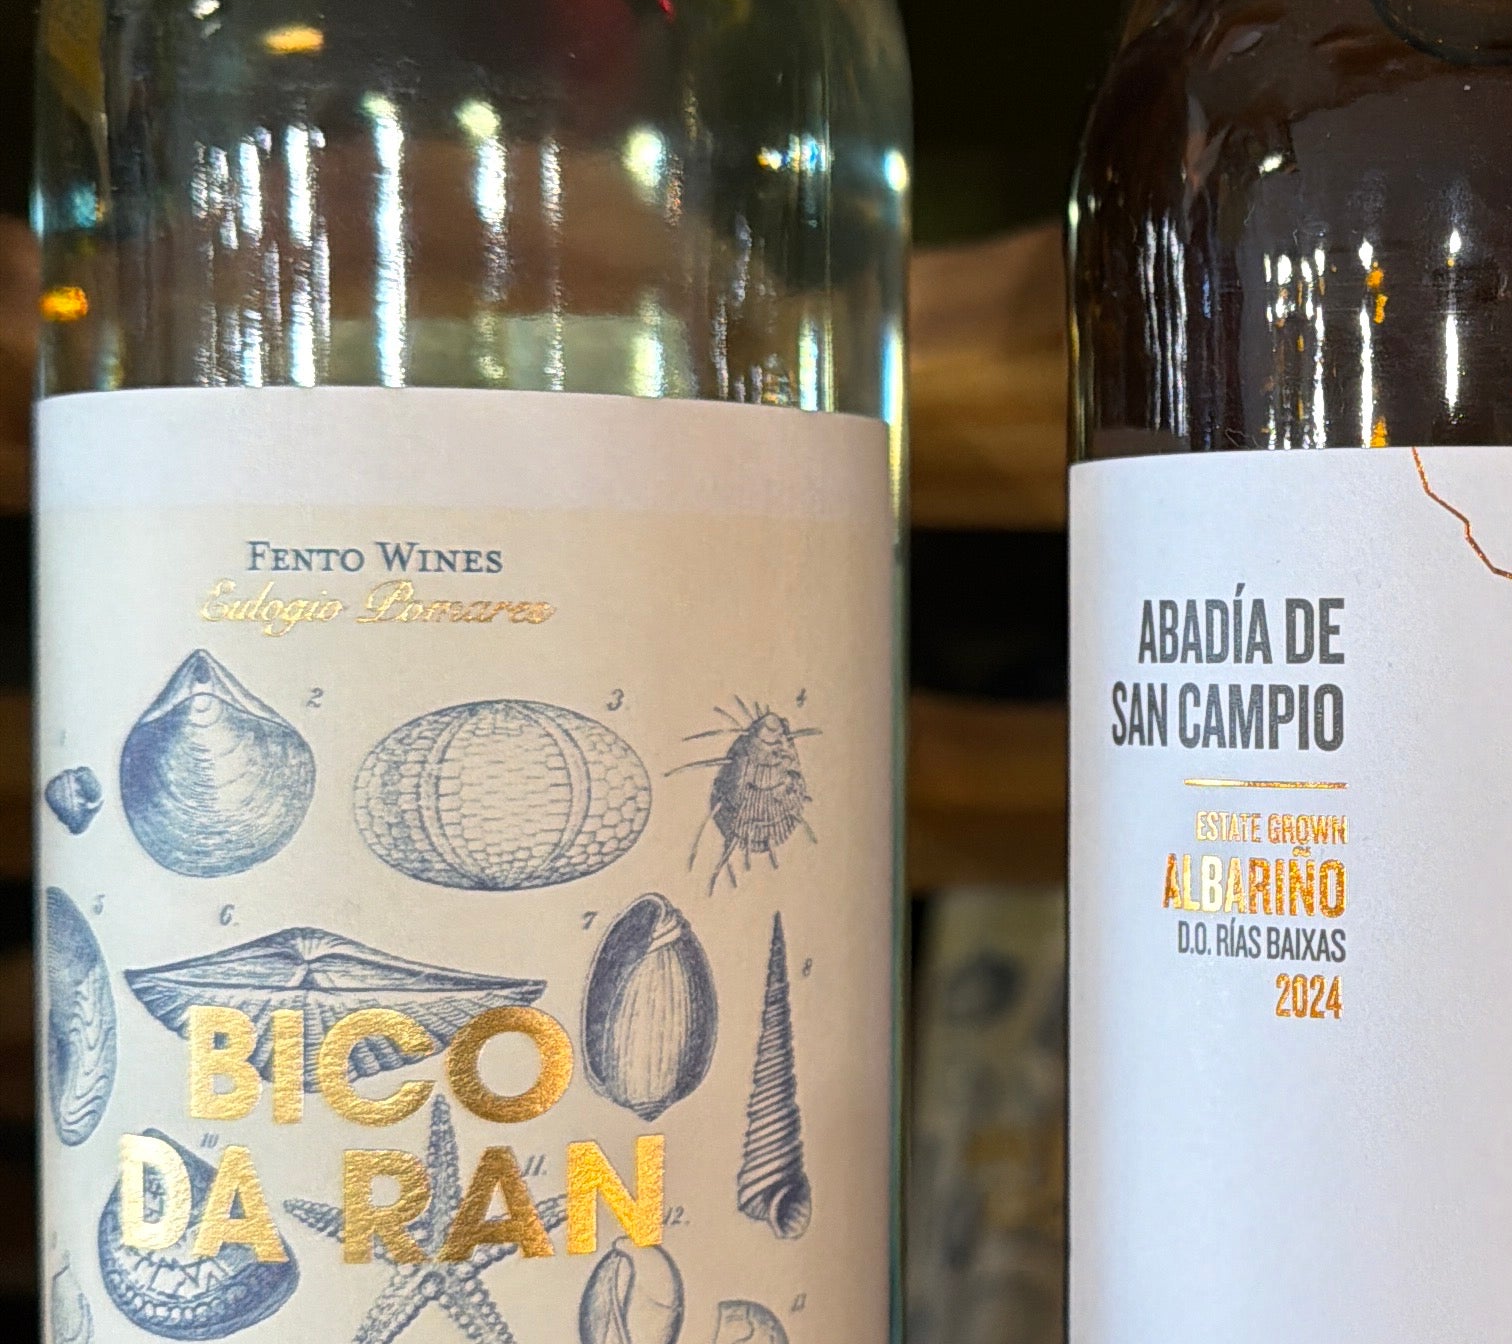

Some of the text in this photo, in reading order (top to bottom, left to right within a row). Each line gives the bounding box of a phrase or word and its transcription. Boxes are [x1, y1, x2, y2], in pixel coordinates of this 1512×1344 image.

[246, 541, 504, 574] FENTO WINES
[201, 577, 347, 638] Eulogio
[1137, 582, 1346, 665] ABADÍA DE
[305, 687, 324, 709] 2
[606, 688, 624, 711] 3
[1111, 680, 1345, 753] SAN CAMPIO
[1196, 810, 1348, 846] ESTATE GROWN
[1161, 845, 1347, 919] ALBARIÑO
[1178, 917, 1347, 963] D.O. RÍAS BAIXAS
[1275, 972, 1343, 1019] 2024
[186, 1005, 575, 1127] BICO
[118, 1130, 667, 1265] DA RAN
